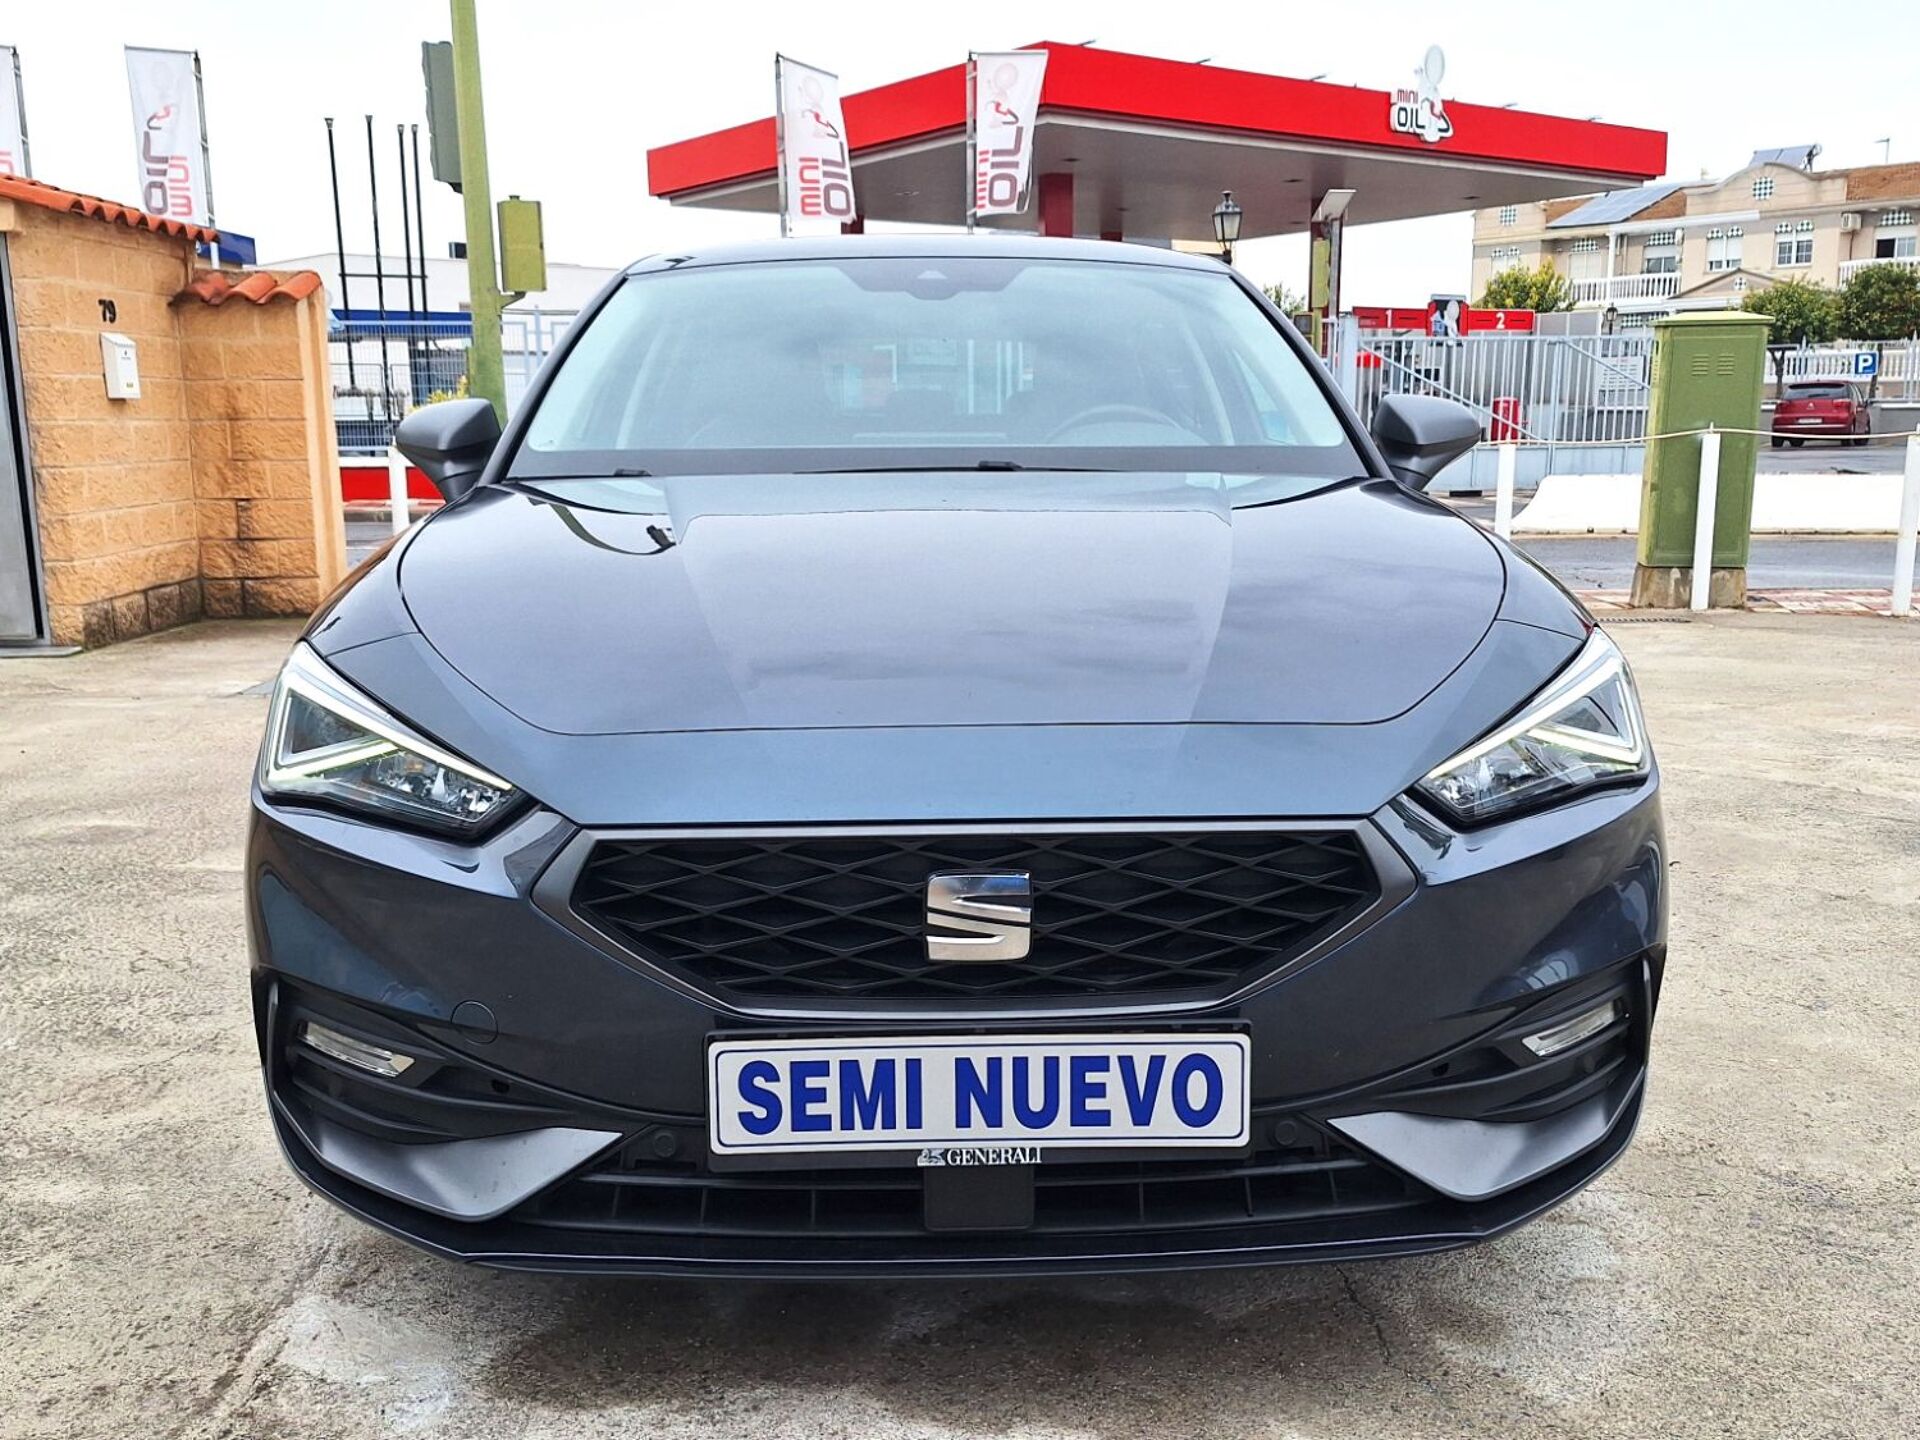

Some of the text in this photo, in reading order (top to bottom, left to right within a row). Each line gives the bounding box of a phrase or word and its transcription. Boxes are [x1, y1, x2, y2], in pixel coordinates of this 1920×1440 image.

[1397, 106, 1425, 130] OIL
[821, 140, 851, 216] OIL
[988, 126, 1023, 208] OIL
[798, 156, 821, 215] mini
[98, 299, 116, 323] 79
[1385, 309, 1392, 328] 1
[1496, 312, 1505, 329] 2
[1857, 355, 1873, 373] P
[737, 1053, 1223, 1135] SEMI NUEVO
[946, 1147, 1042, 1166] GENERALI
